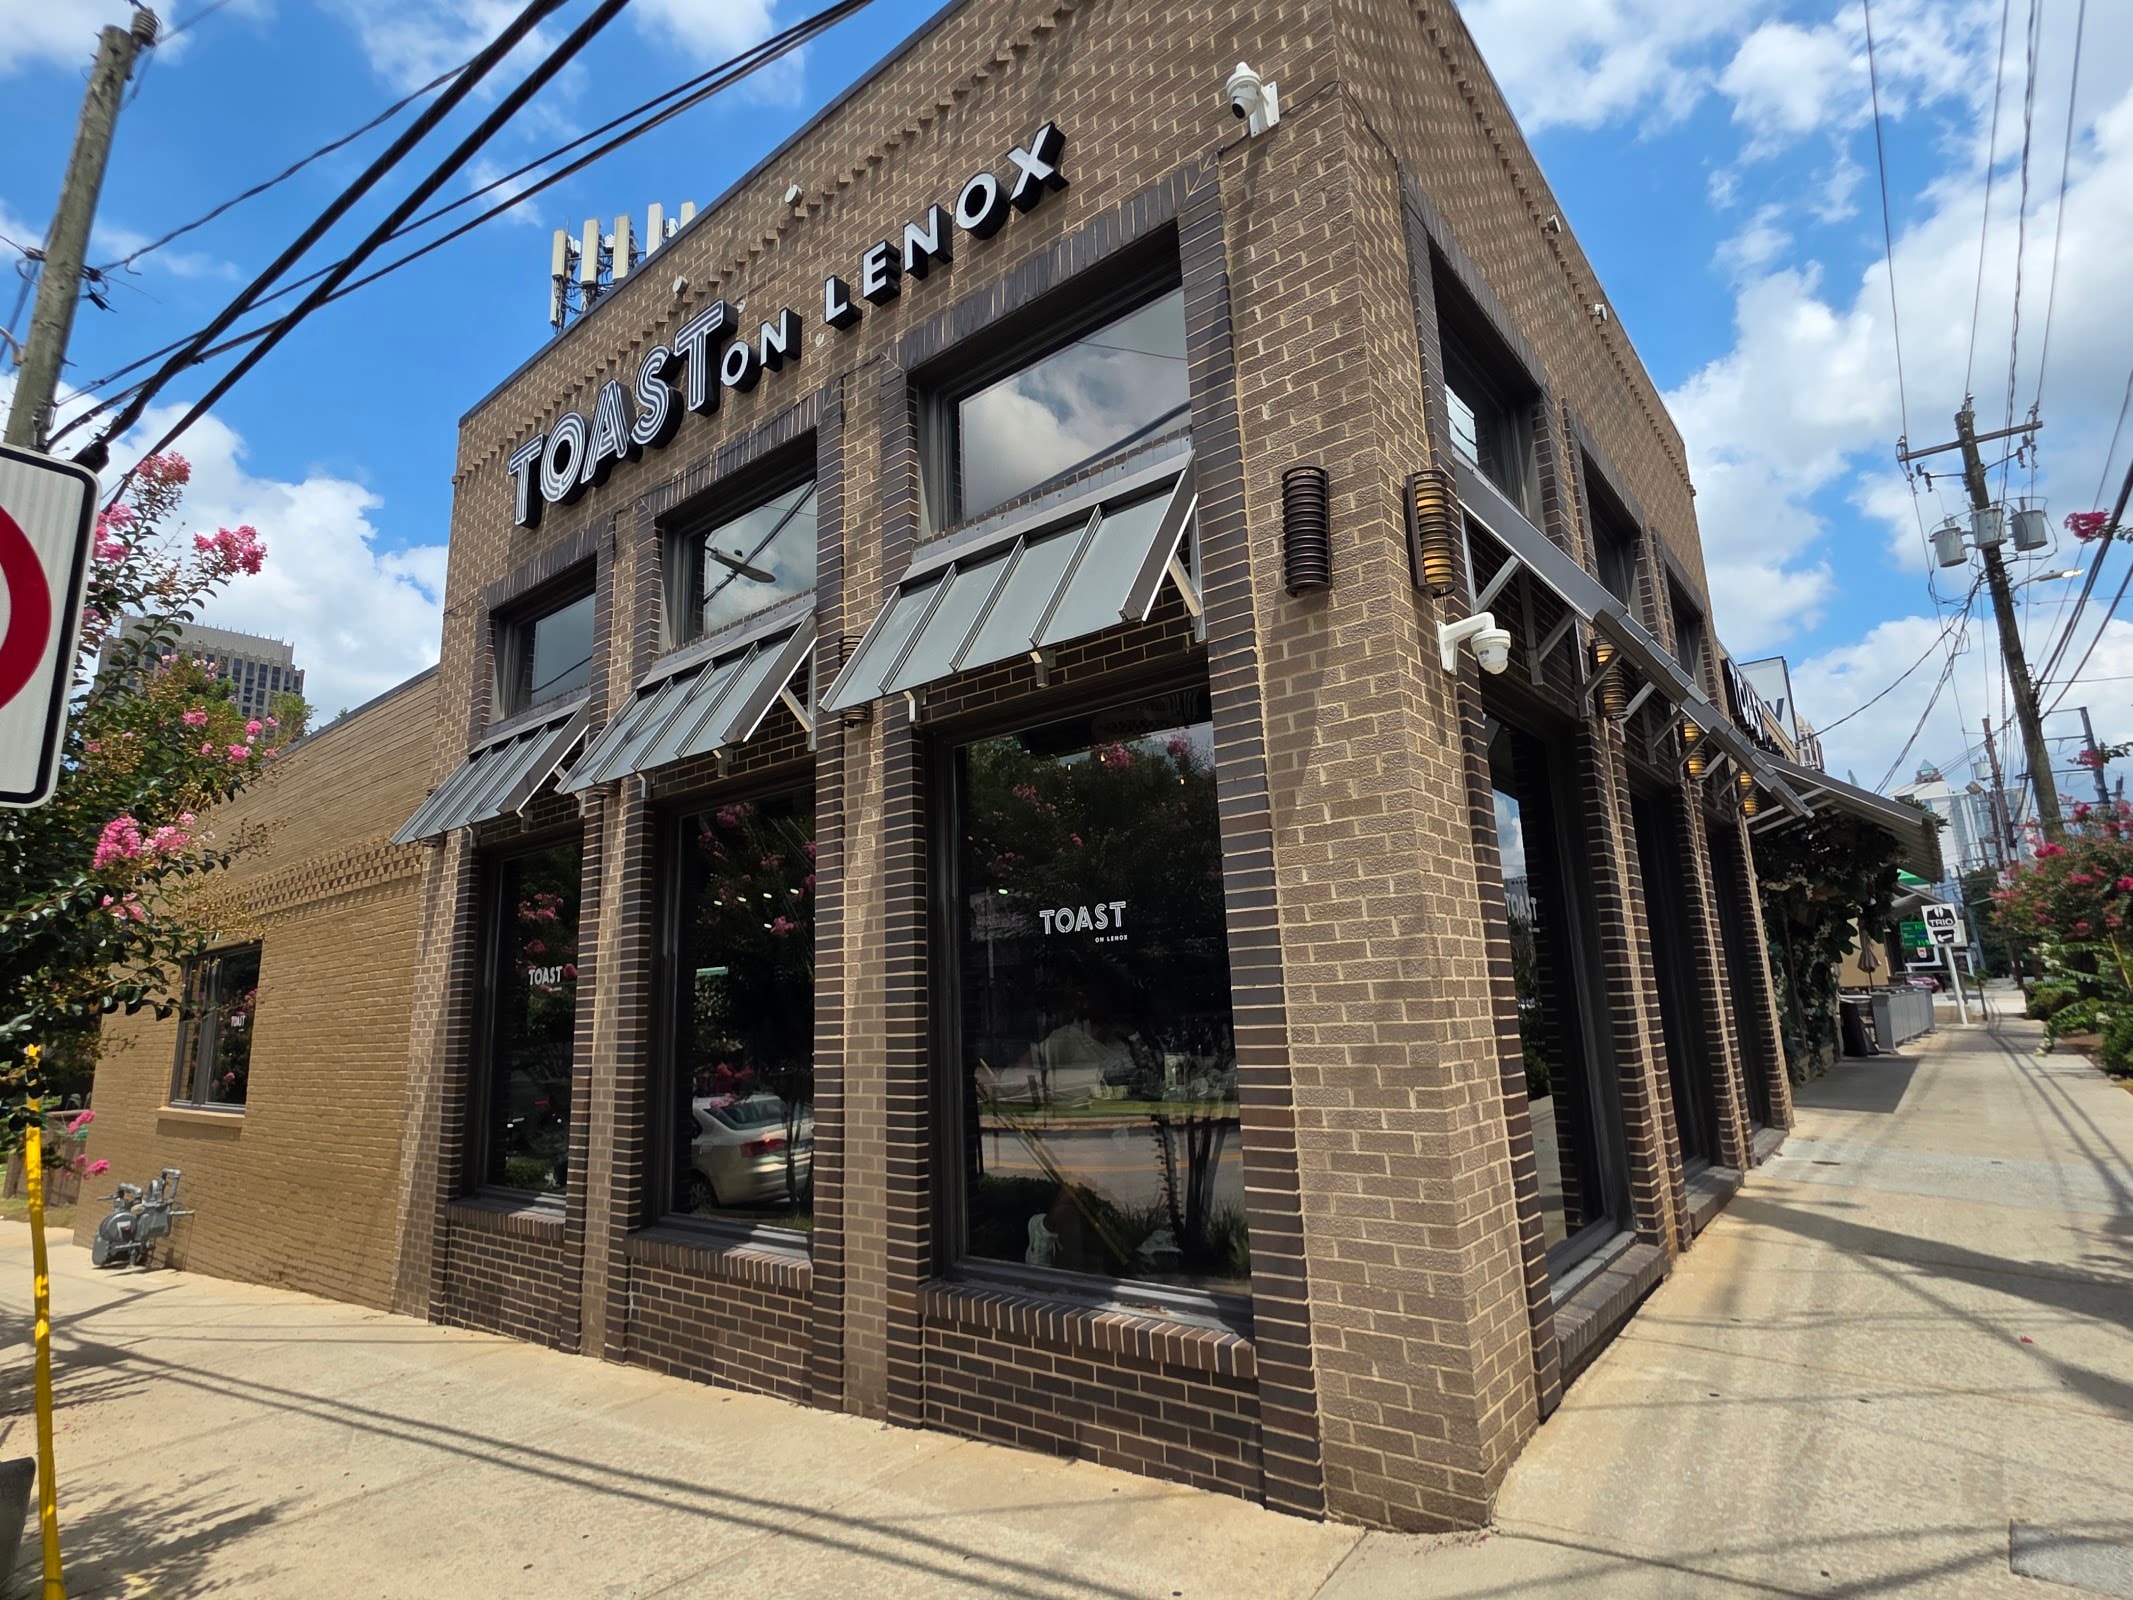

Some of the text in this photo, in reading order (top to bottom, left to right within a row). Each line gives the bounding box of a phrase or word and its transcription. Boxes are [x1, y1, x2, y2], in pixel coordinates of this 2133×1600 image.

[508, 120, 1069, 529] TOAST ON LENOX
[1039, 901, 1127, 935] TOAST
[1504, 892, 1537, 921] TOAST
[1929, 917, 1955, 927] TRIO
[1106, 934, 1128, 943] LENOX
[528, 966, 563, 986] TOAST
